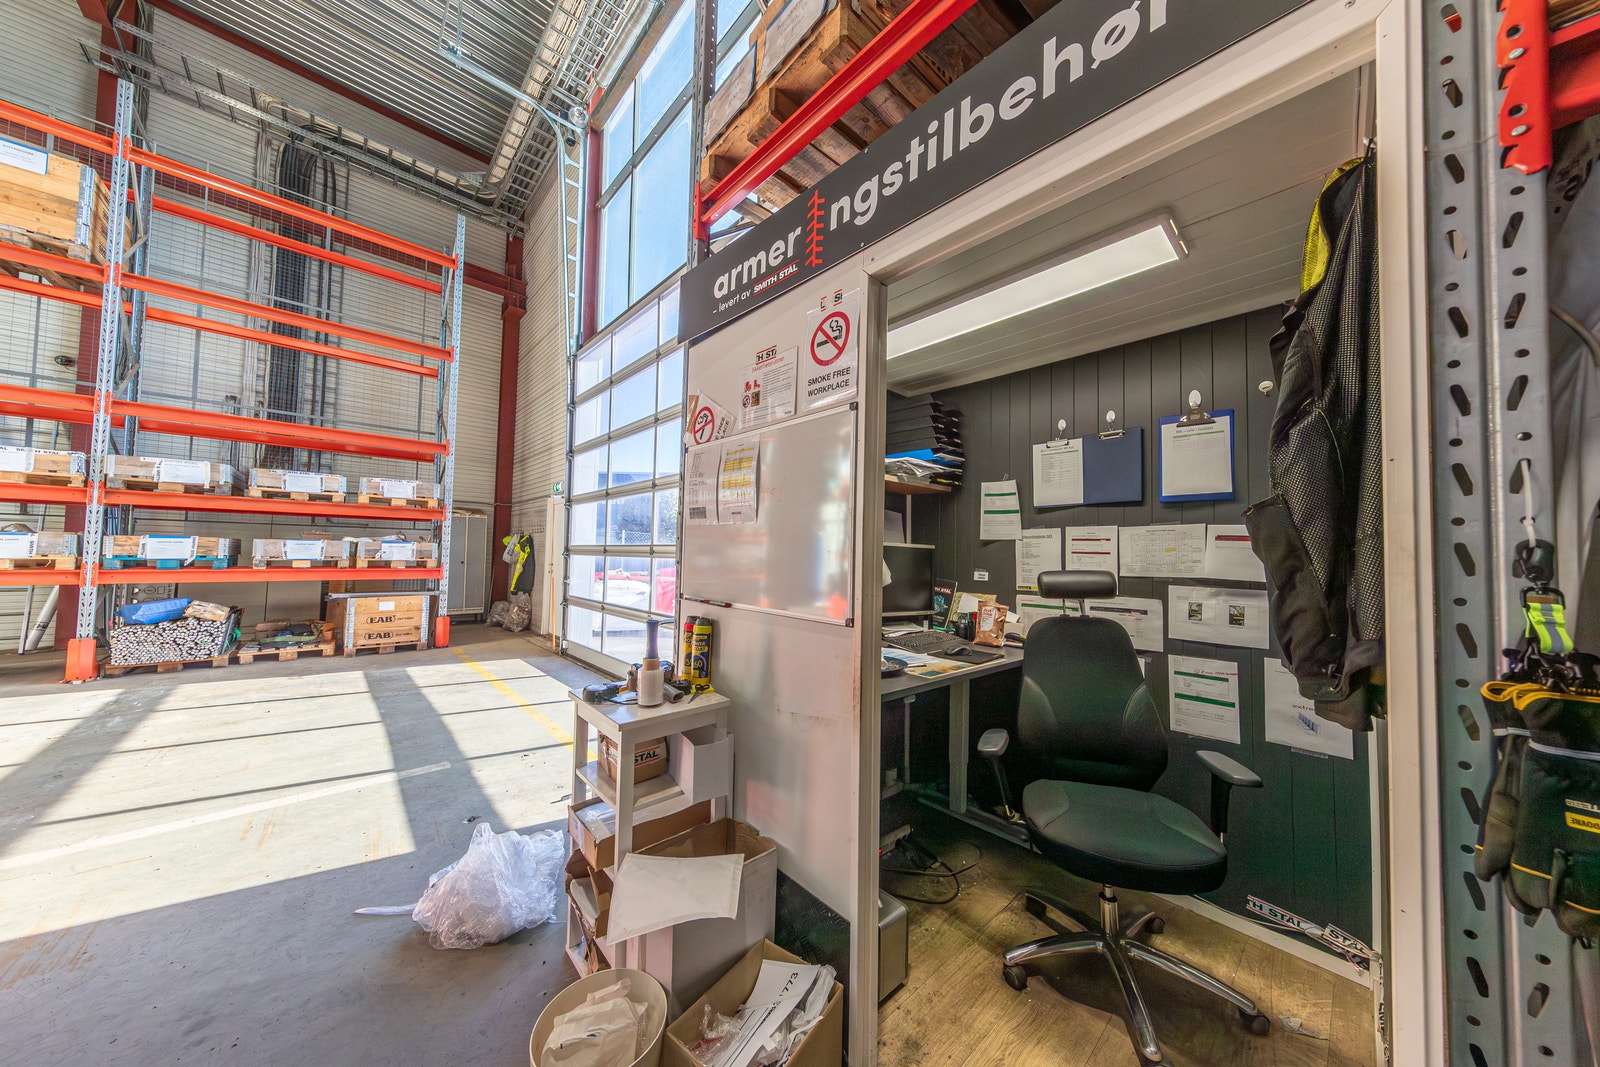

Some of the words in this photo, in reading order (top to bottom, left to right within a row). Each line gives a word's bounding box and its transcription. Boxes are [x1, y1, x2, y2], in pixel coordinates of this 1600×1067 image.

[718, 292, 740, 313] levert
[740, 288, 751, 301] av
[753, 275, 778, 294] SMITH
[808, 373, 831, 387] SMOKE
[832, 366, 851, 379] FREE
[808, 379, 850, 397] WORKPLACE
[370, 616, 393, 624] EAB
[367, 632, 391, 640] EAB
